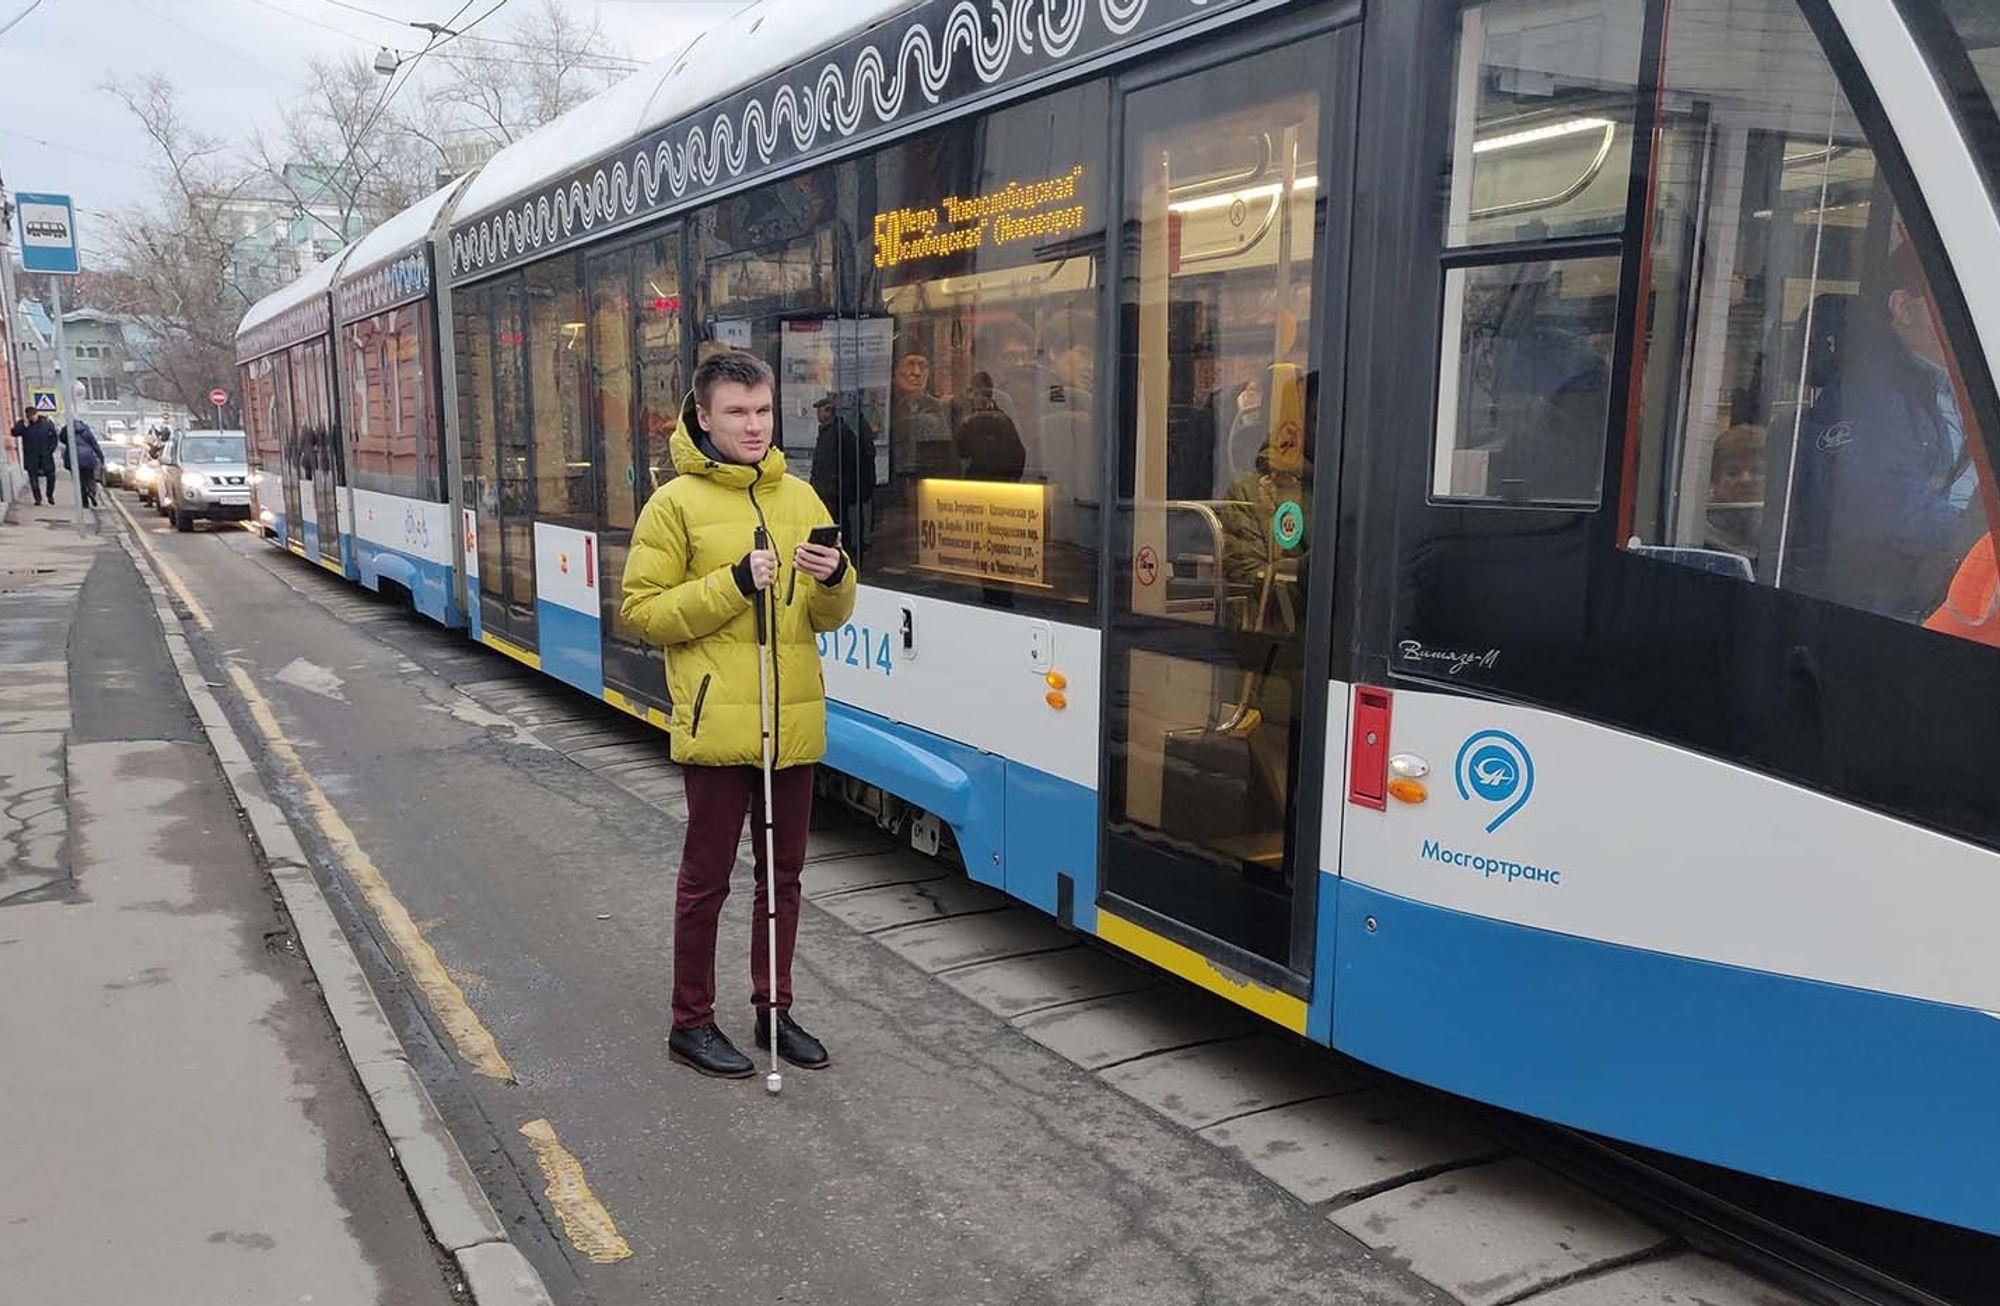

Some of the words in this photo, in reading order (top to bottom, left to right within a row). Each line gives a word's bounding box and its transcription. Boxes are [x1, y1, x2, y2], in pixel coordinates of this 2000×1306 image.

[874, 211, 899, 268] 50
[921, 520, 936, 550] 50
[1421, 839, 1561, 885] Мосгортранс
